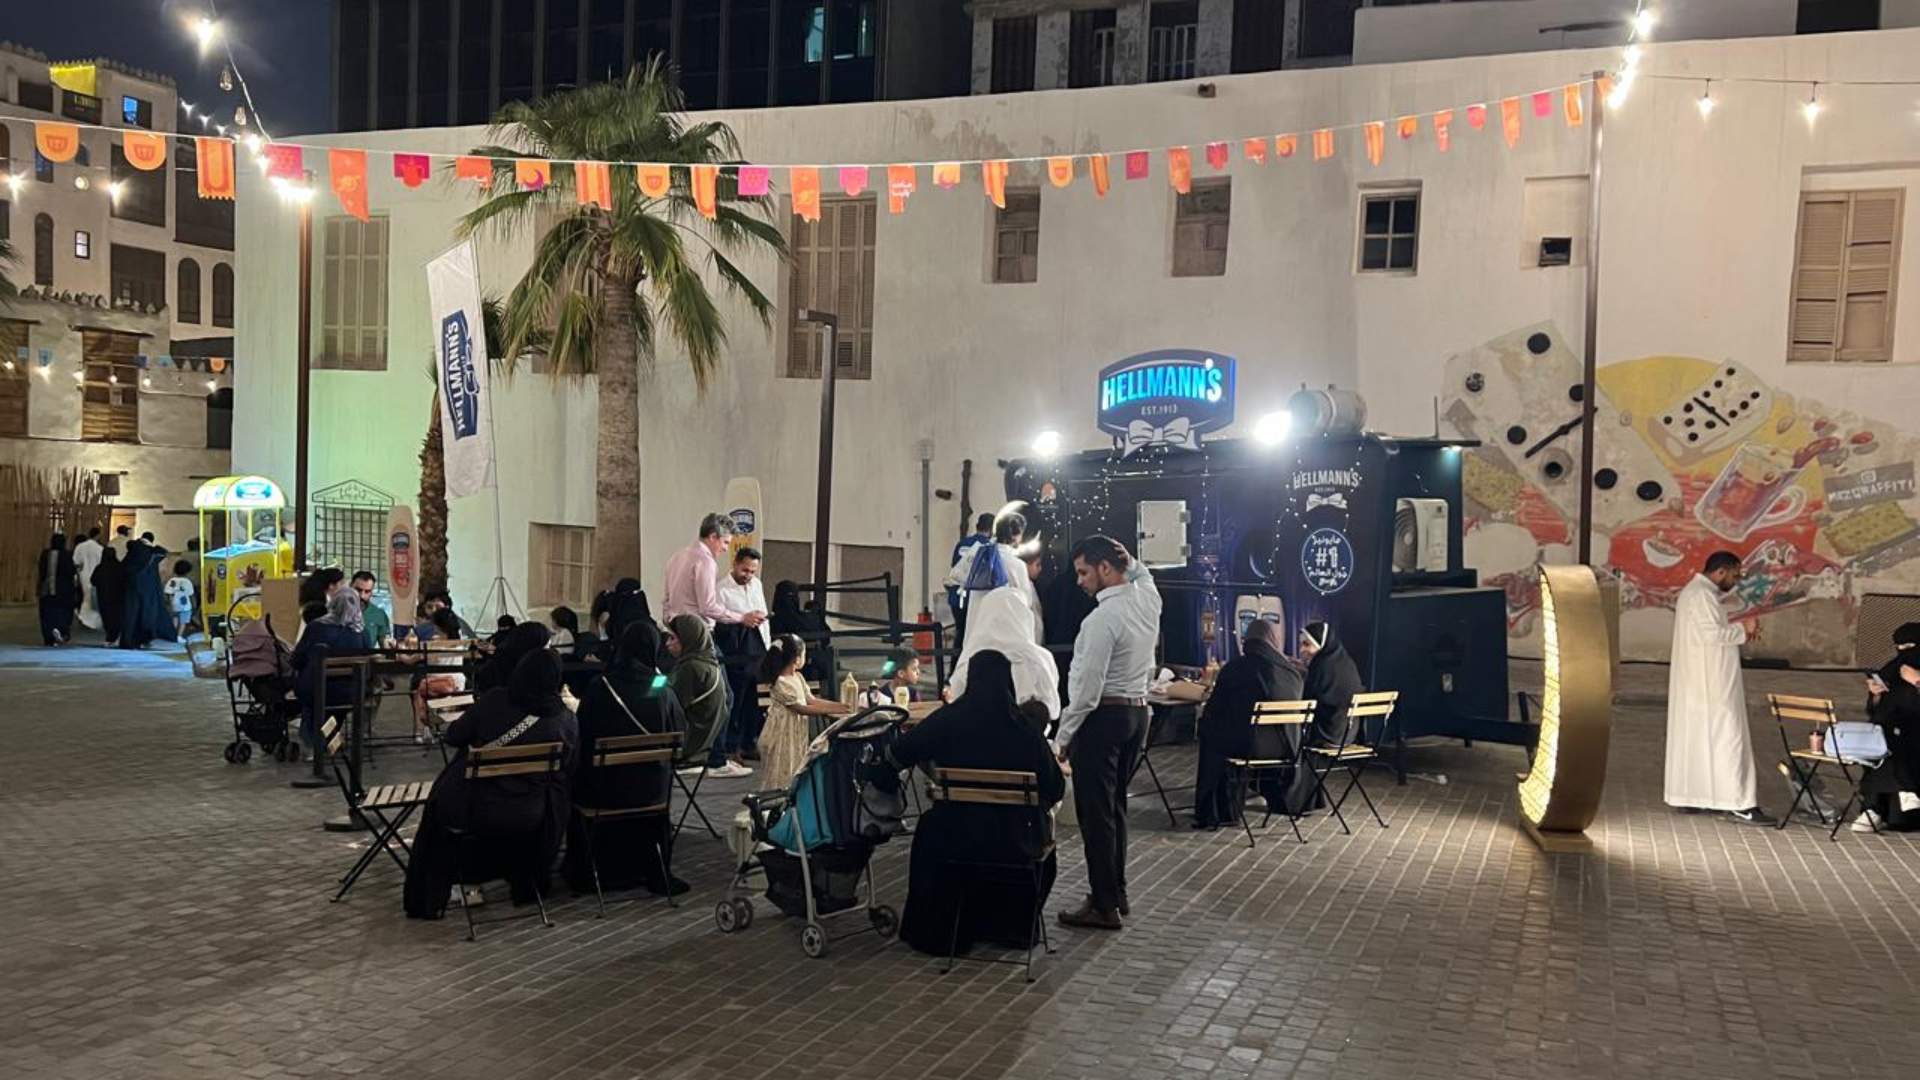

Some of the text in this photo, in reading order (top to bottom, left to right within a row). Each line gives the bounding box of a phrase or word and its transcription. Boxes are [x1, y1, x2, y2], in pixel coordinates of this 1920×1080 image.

[1102, 358, 1222, 411] HELLMANN'S
[1293, 468, 1360, 490] HELLMANN'S
[1315, 547, 1339, 567] #1
